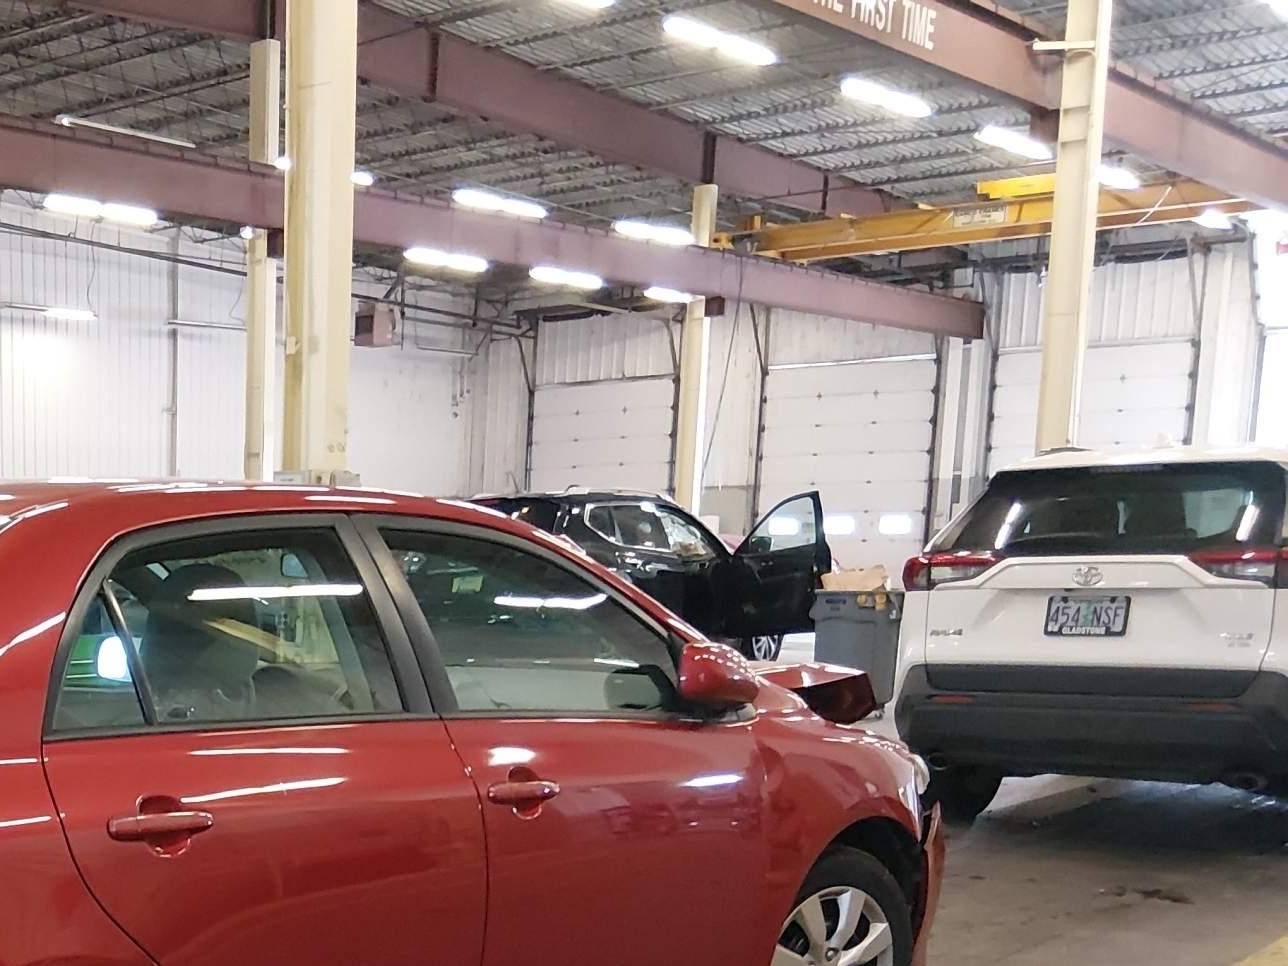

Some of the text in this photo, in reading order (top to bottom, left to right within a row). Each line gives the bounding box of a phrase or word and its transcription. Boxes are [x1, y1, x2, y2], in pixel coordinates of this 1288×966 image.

[902, 1, 937, 50] TIME
[1048, 605, 1124, 627] 454 NSF
